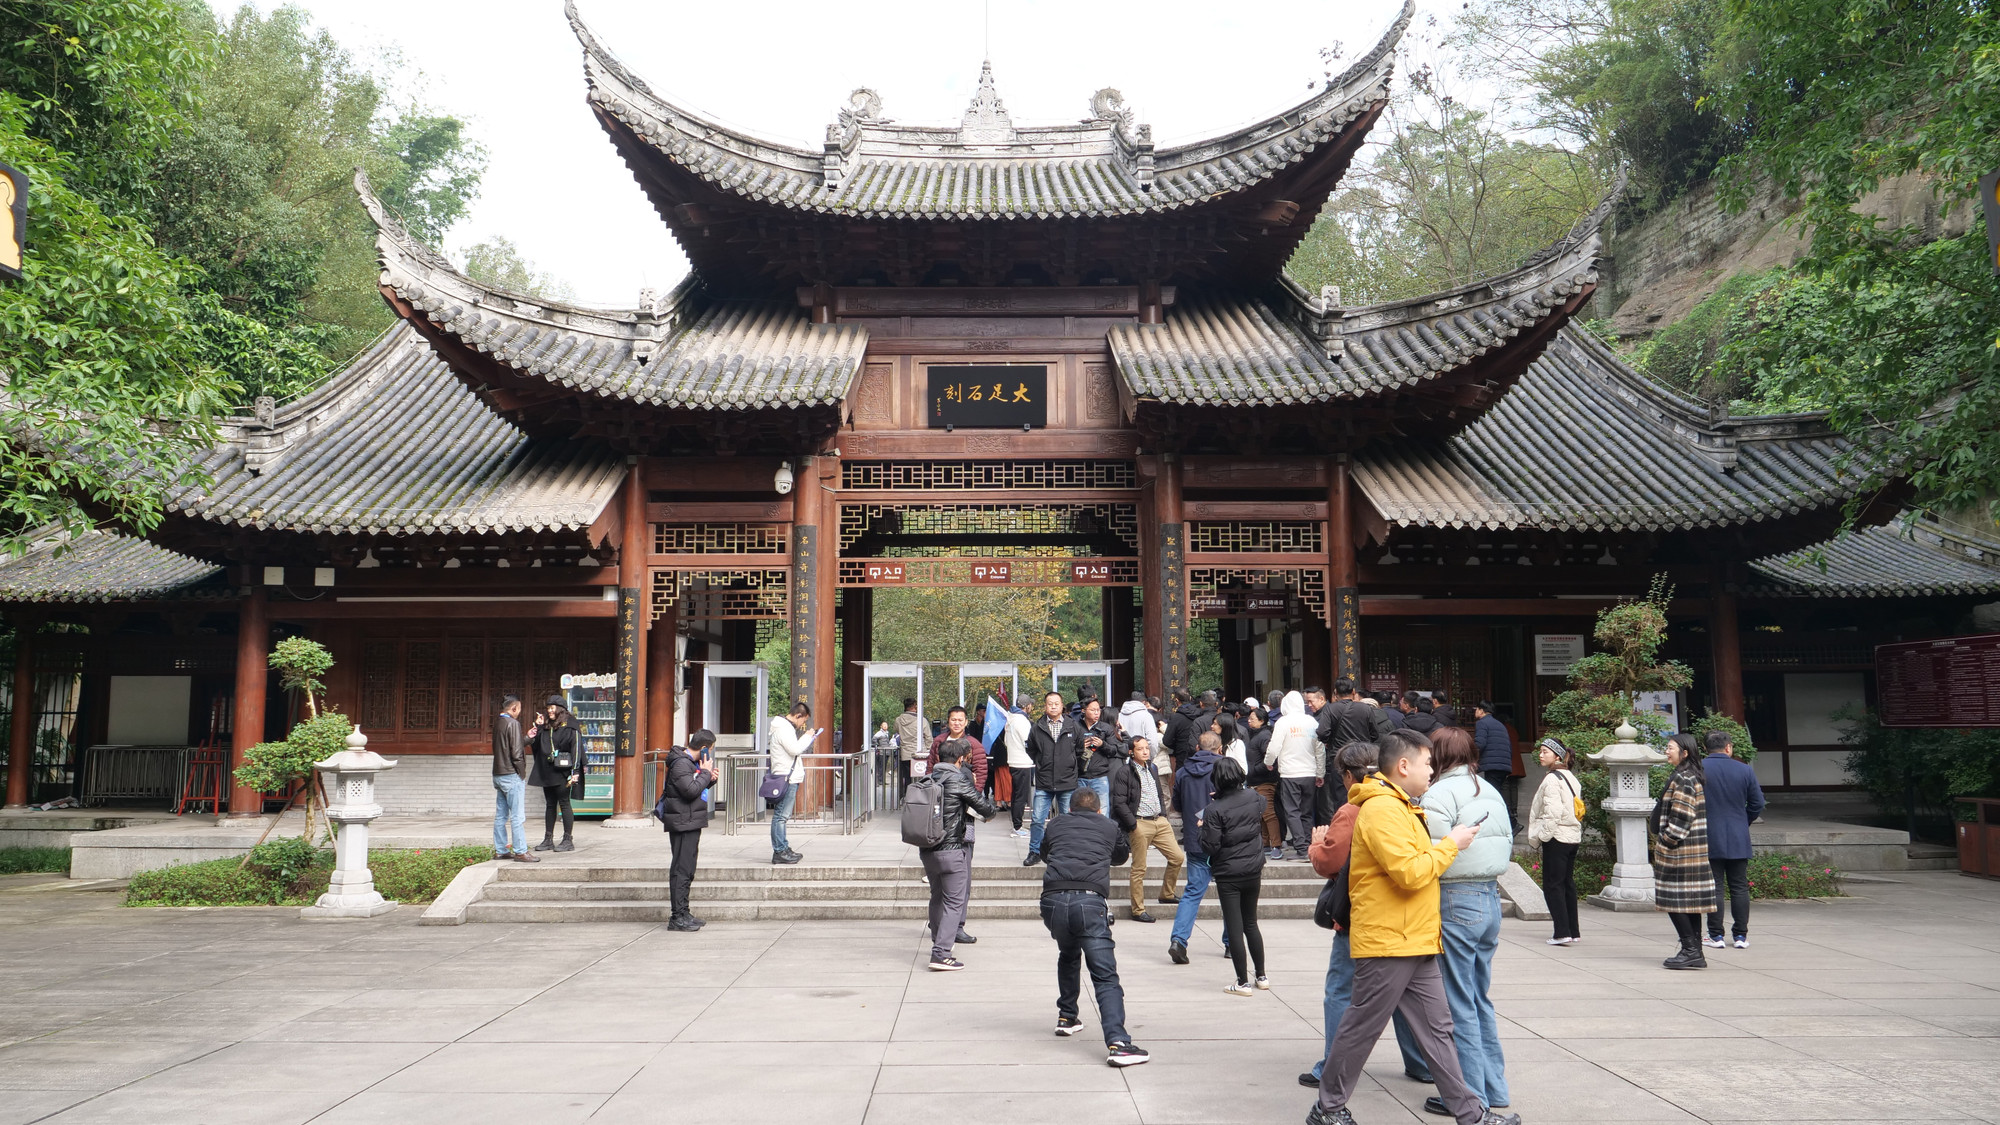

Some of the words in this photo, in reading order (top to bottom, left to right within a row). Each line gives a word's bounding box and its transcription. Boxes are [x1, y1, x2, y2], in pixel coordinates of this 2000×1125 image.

[943, 383, 1031, 403] 大足石刻
[884, 567, 902, 575] 入口
[990, 566, 1007, 574] 入口
[1090, 566, 1108, 574] 入口
